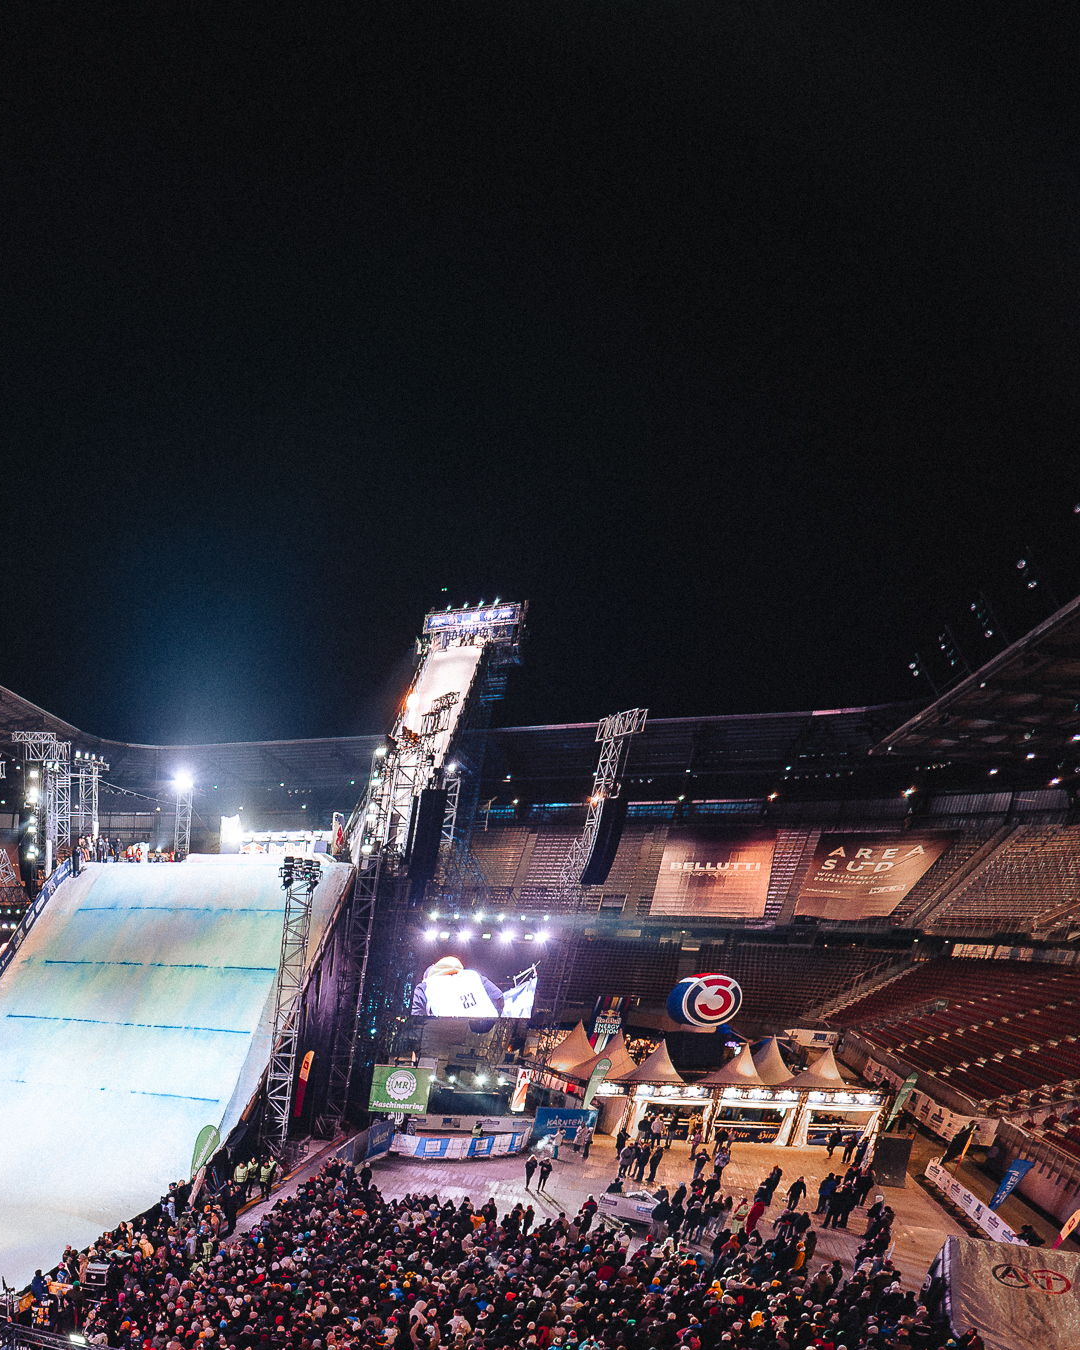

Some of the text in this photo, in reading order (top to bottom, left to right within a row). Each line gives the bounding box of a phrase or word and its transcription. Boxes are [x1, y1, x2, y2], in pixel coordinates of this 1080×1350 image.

[828, 845, 927, 859] AREA
[670, 862, 762, 871] BELLUTTI
[821, 859, 894, 873] SÜD
[394, 1080, 410, 1090] MR
[372, 1100, 425, 1111] Maschinenring
